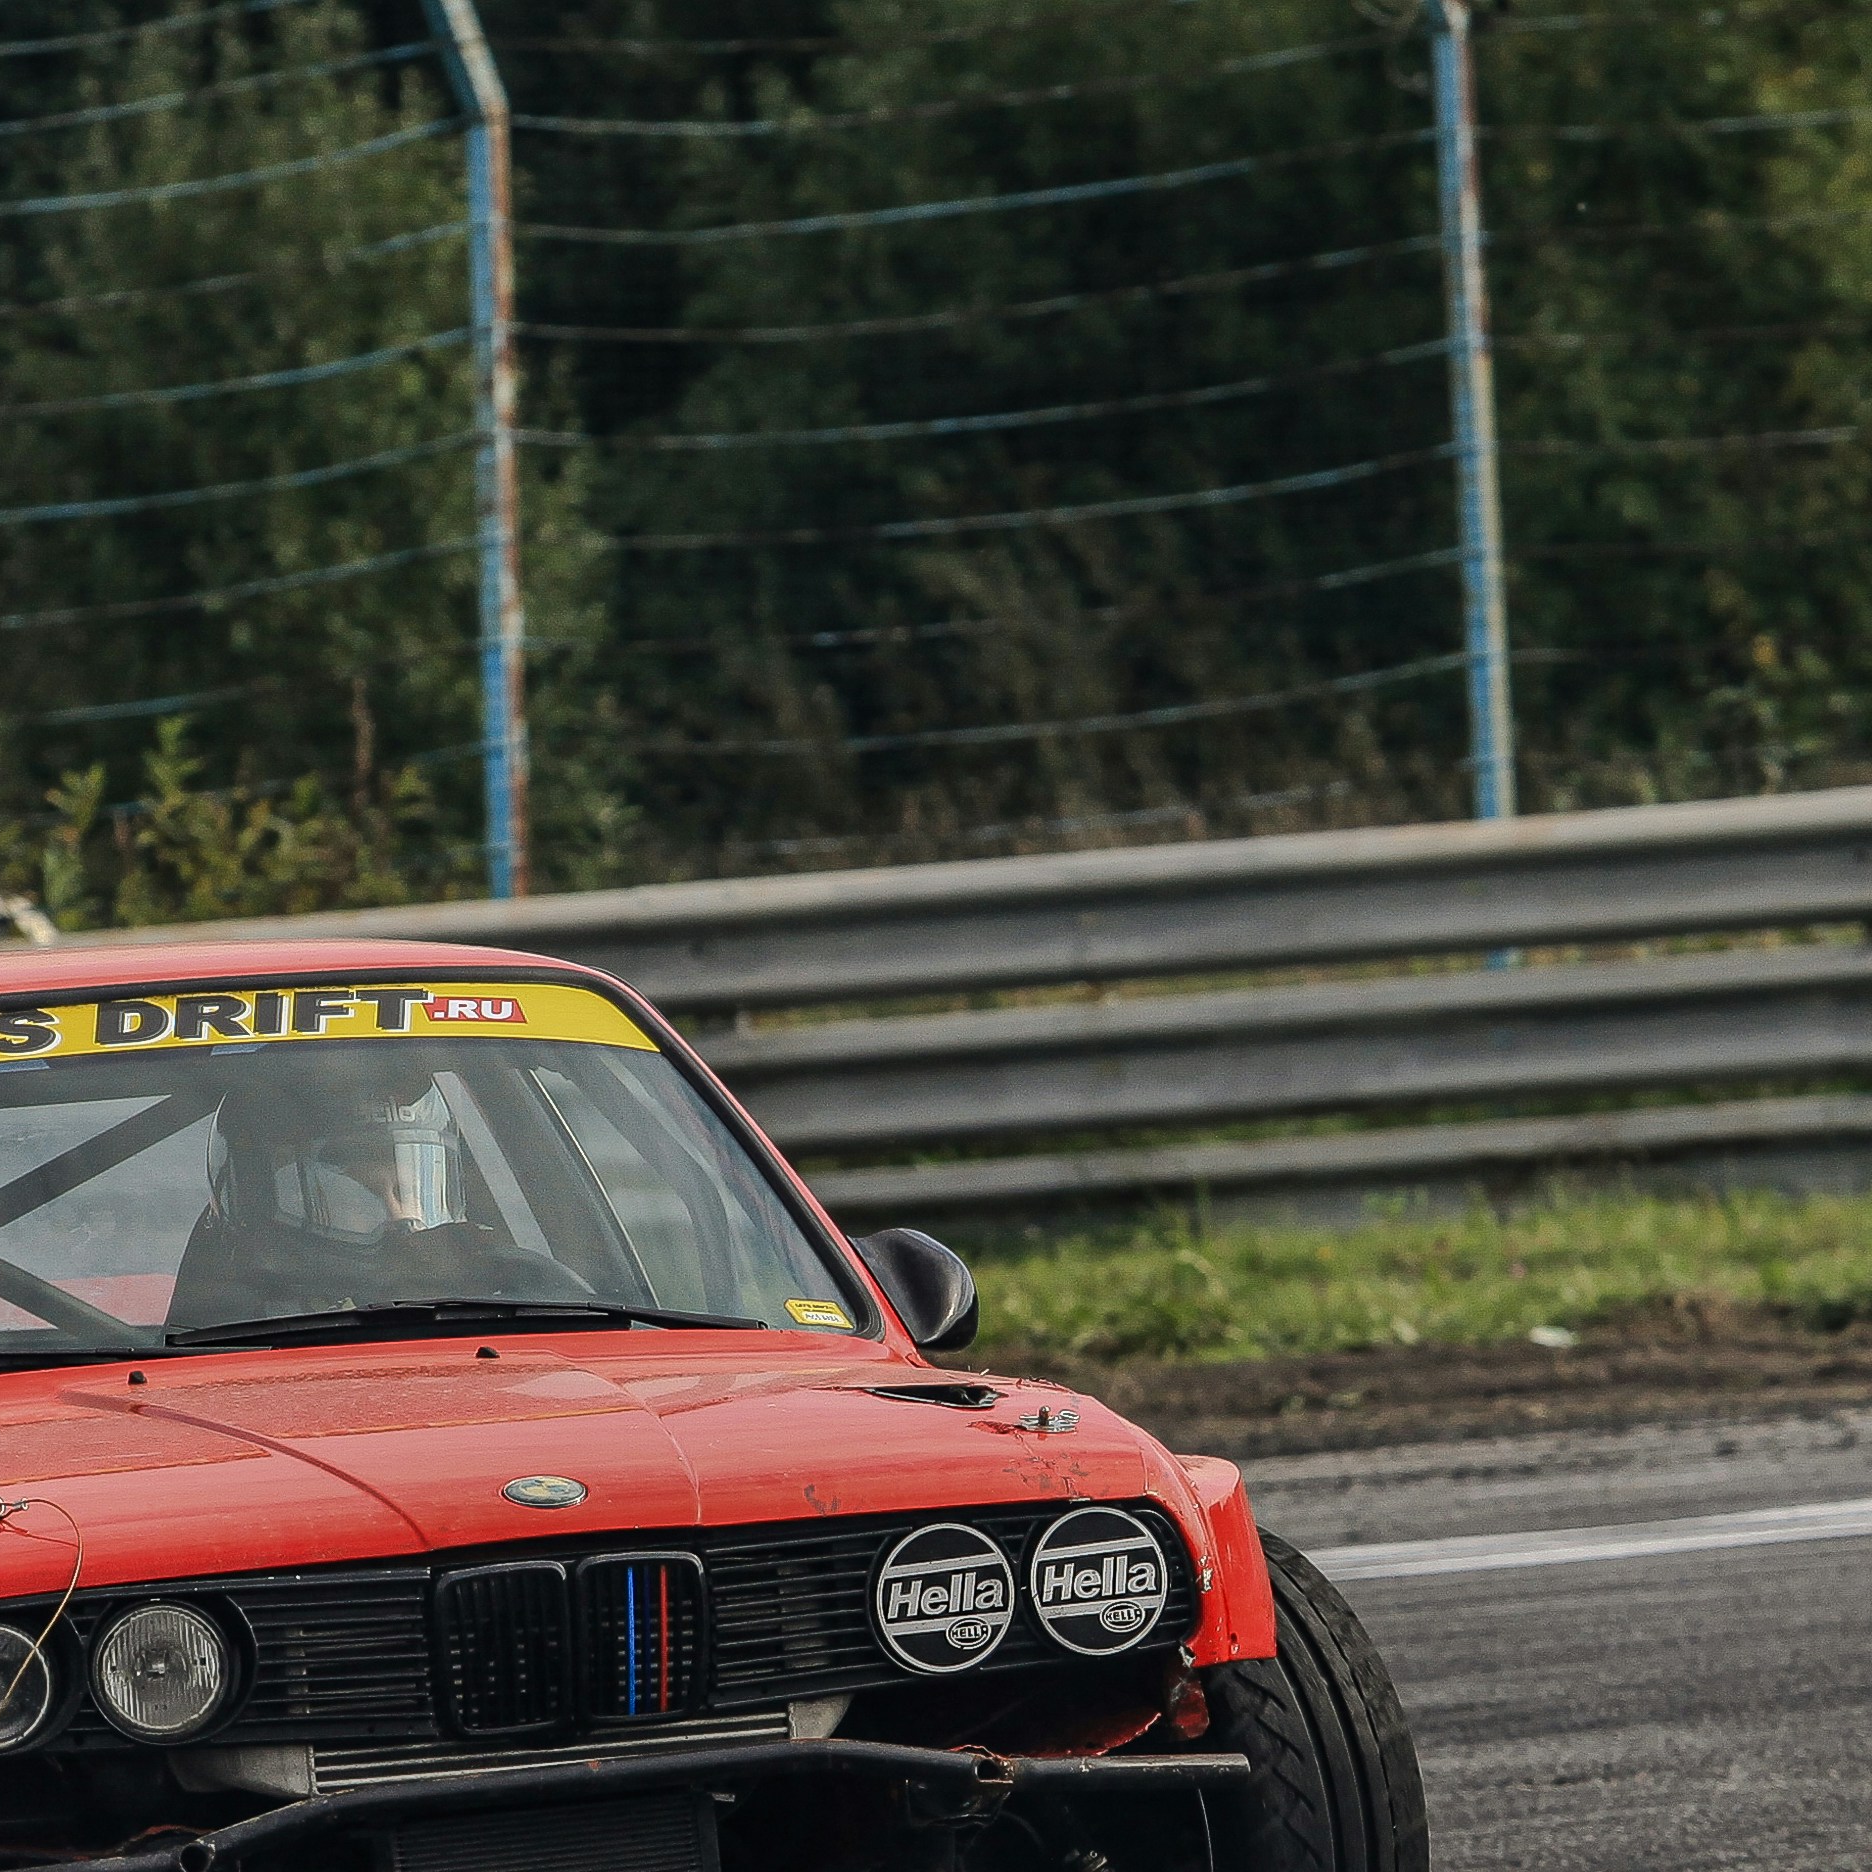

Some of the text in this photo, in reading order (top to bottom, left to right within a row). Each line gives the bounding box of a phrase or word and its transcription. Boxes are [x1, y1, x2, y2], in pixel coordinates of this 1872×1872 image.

[94, 988, 434, 1045] DRIFT
[887, 1570, 1005, 1620] Hella
[1042, 1553, 1158, 1603] Hella
[950, 1624, 989, 1640] HELLA
[1105, 1609, 1143, 1623] HELLA
